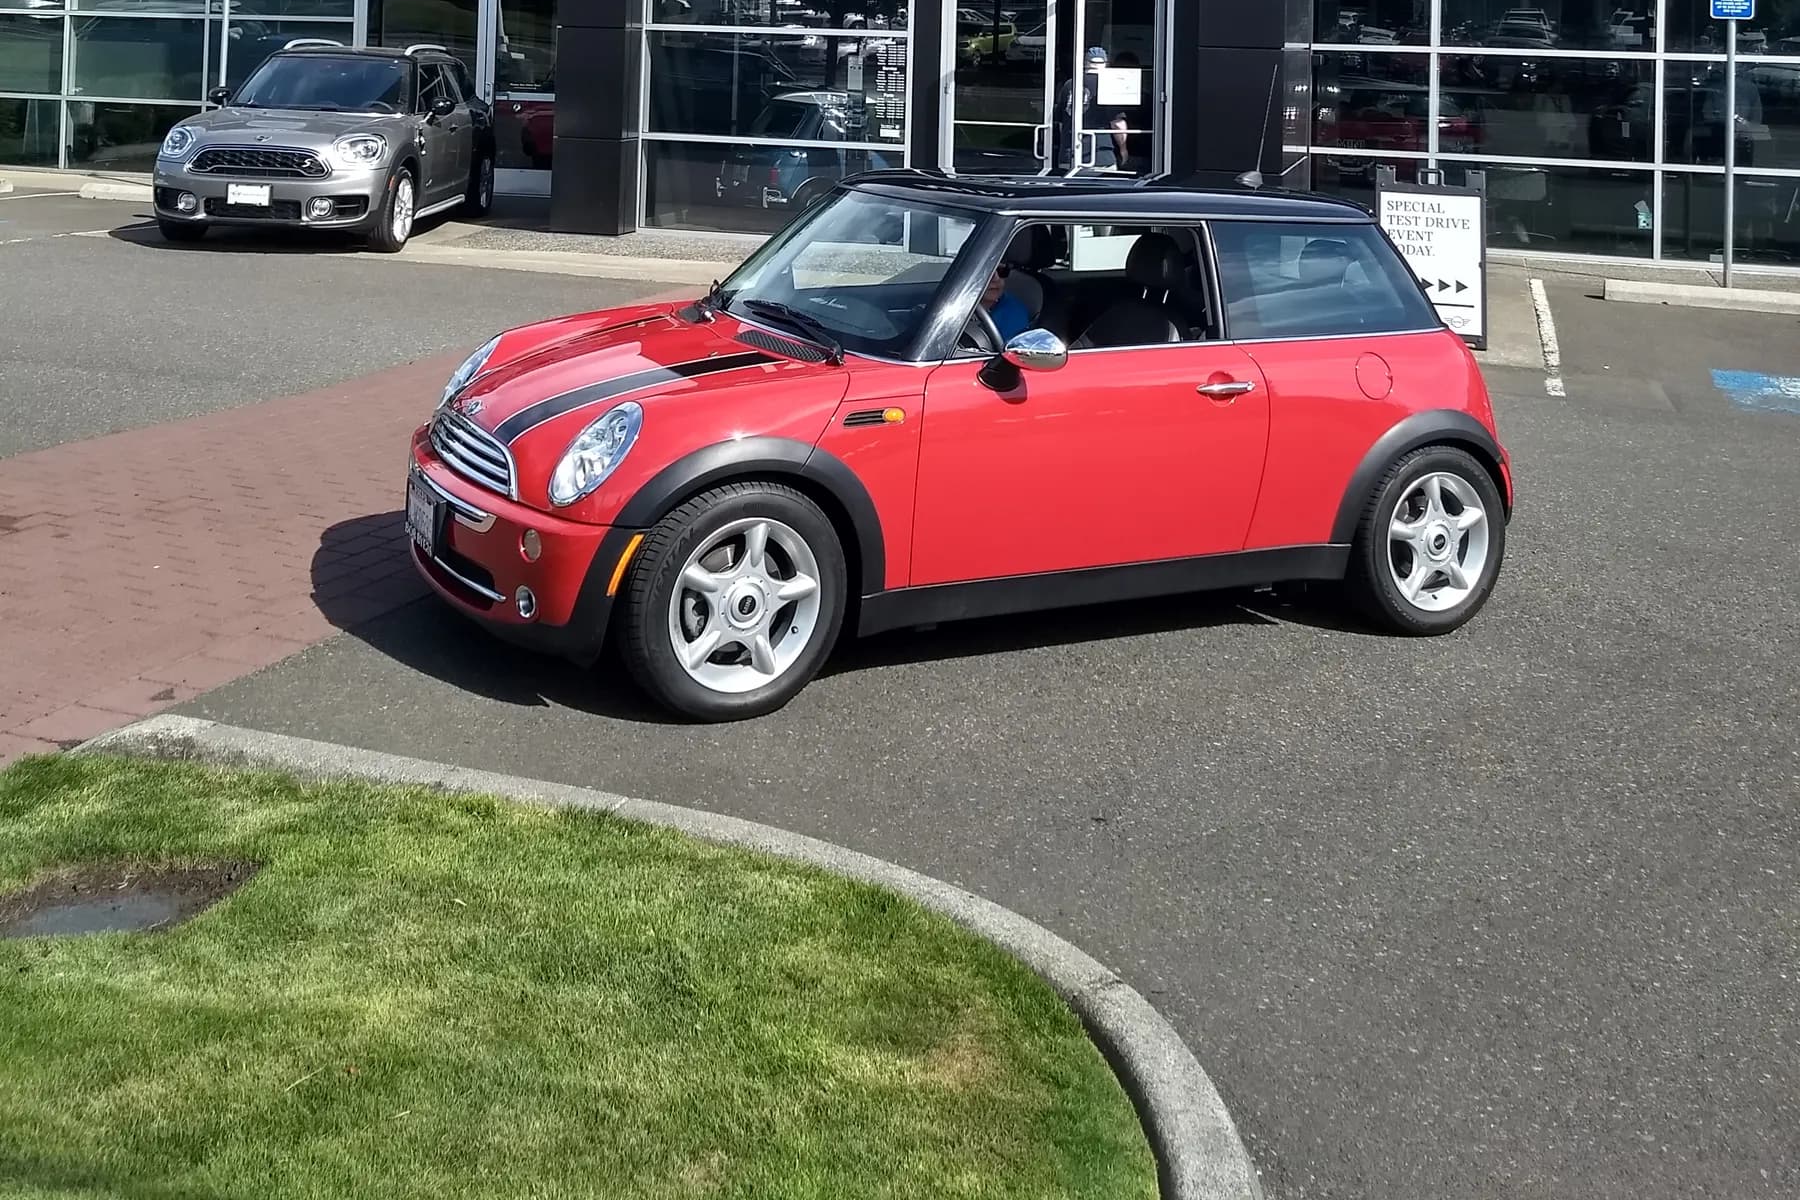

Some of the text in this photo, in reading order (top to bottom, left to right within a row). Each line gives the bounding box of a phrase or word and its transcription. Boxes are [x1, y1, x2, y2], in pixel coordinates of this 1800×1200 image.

[1386, 200, 1445, 214] SPECIAL
[1387, 214, 1470, 230] TEST DRIVE
[1387, 229, 1434, 242] EVENT
[1396, 244, 1435, 257] ODAY.
